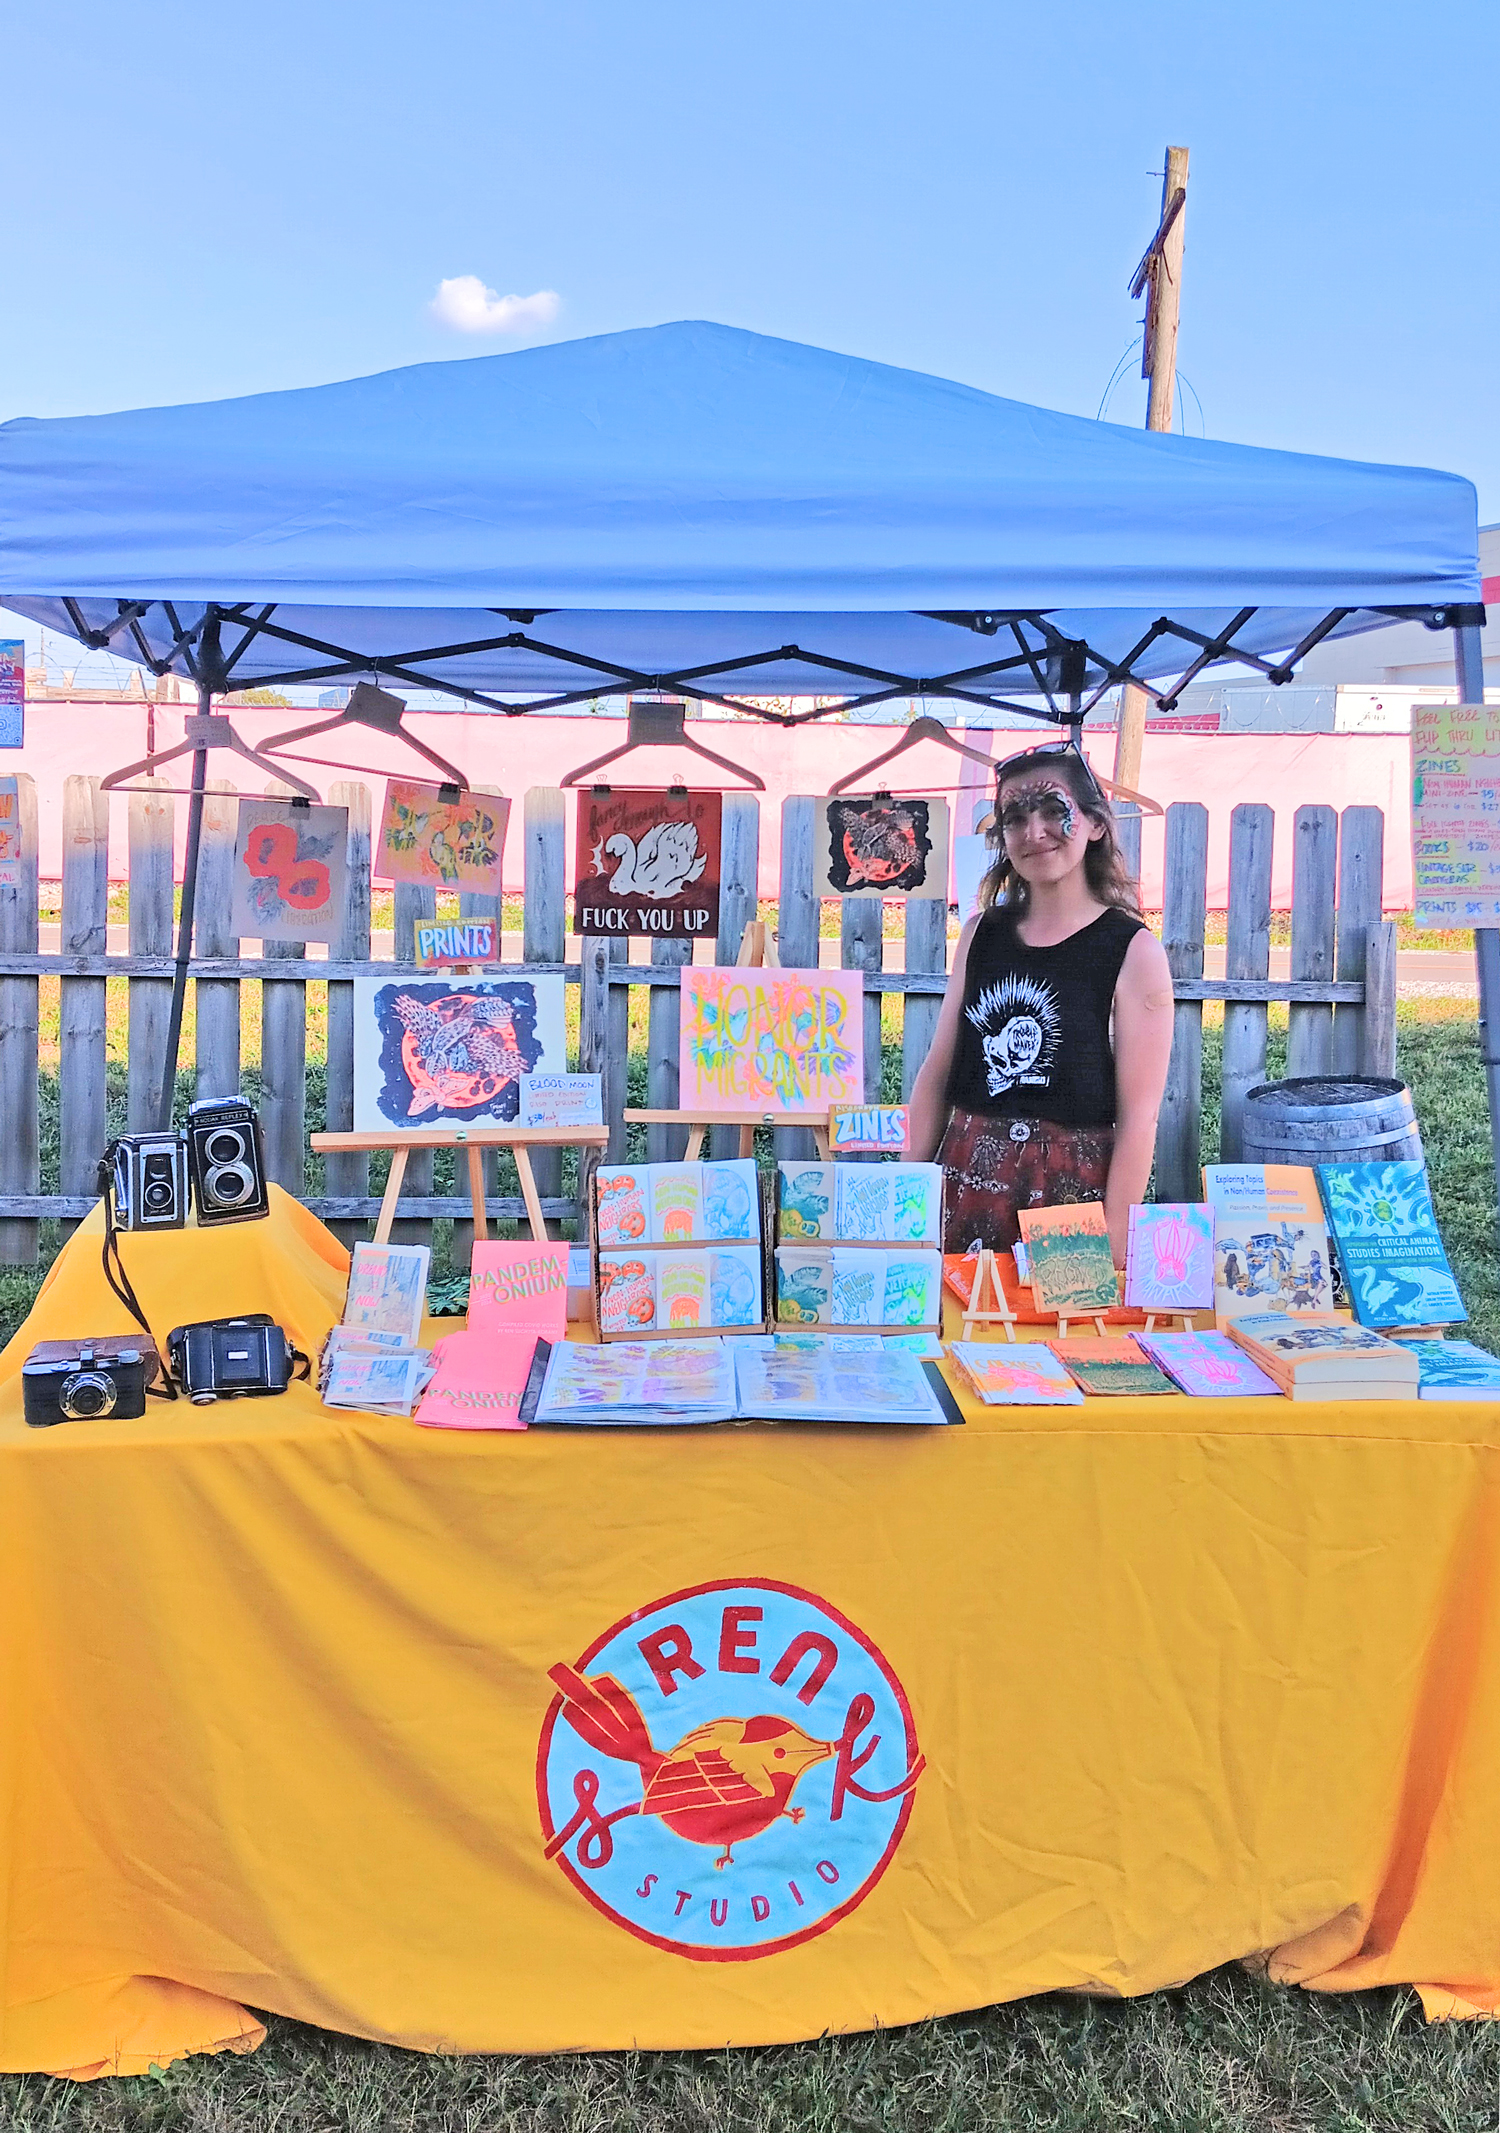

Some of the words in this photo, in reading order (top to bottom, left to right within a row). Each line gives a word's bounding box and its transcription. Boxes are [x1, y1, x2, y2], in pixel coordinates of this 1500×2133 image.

[1415, 708, 1441, 726] FEEL
[1450, 709, 1480, 724] FREE
[1446, 730, 1473, 743] THRU
[1415, 759, 1461, 773] ZINES
[582, 907, 629, 929] FUCK
[637, 908, 674, 931] YOU
[683, 909, 709, 930] UP
[418, 925, 492, 959] PRINTS
[696, 984, 850, 1050] HONOR
[696, 1050, 847, 1099] MIGRANTS
[528, 1079, 566, 1091] BLOOD
[568, 1079, 595, 1089] MOON
[835, 1109, 906, 1143] ZINES
[1215, 1174, 1245, 1185] Exploring
[1245, 1174, 1264, 1185] Topics
[1223, 1187, 1230, 1195] in
[1230, 1187, 1265, 1195] Non/Human
[1377, 1237, 1409, 1247] CRITICAL
[1409, 1236, 1439, 1246] ANIMAL
[1346, 1248, 1381, 1258] STUDIES
[1381, 1246, 1441, 1258] IMAGINATION
[494, 1271, 567, 1304] ONIUM
[452, 1399, 522, 1409] ONIU
[636, 1859, 841, 1927] STUDIO
